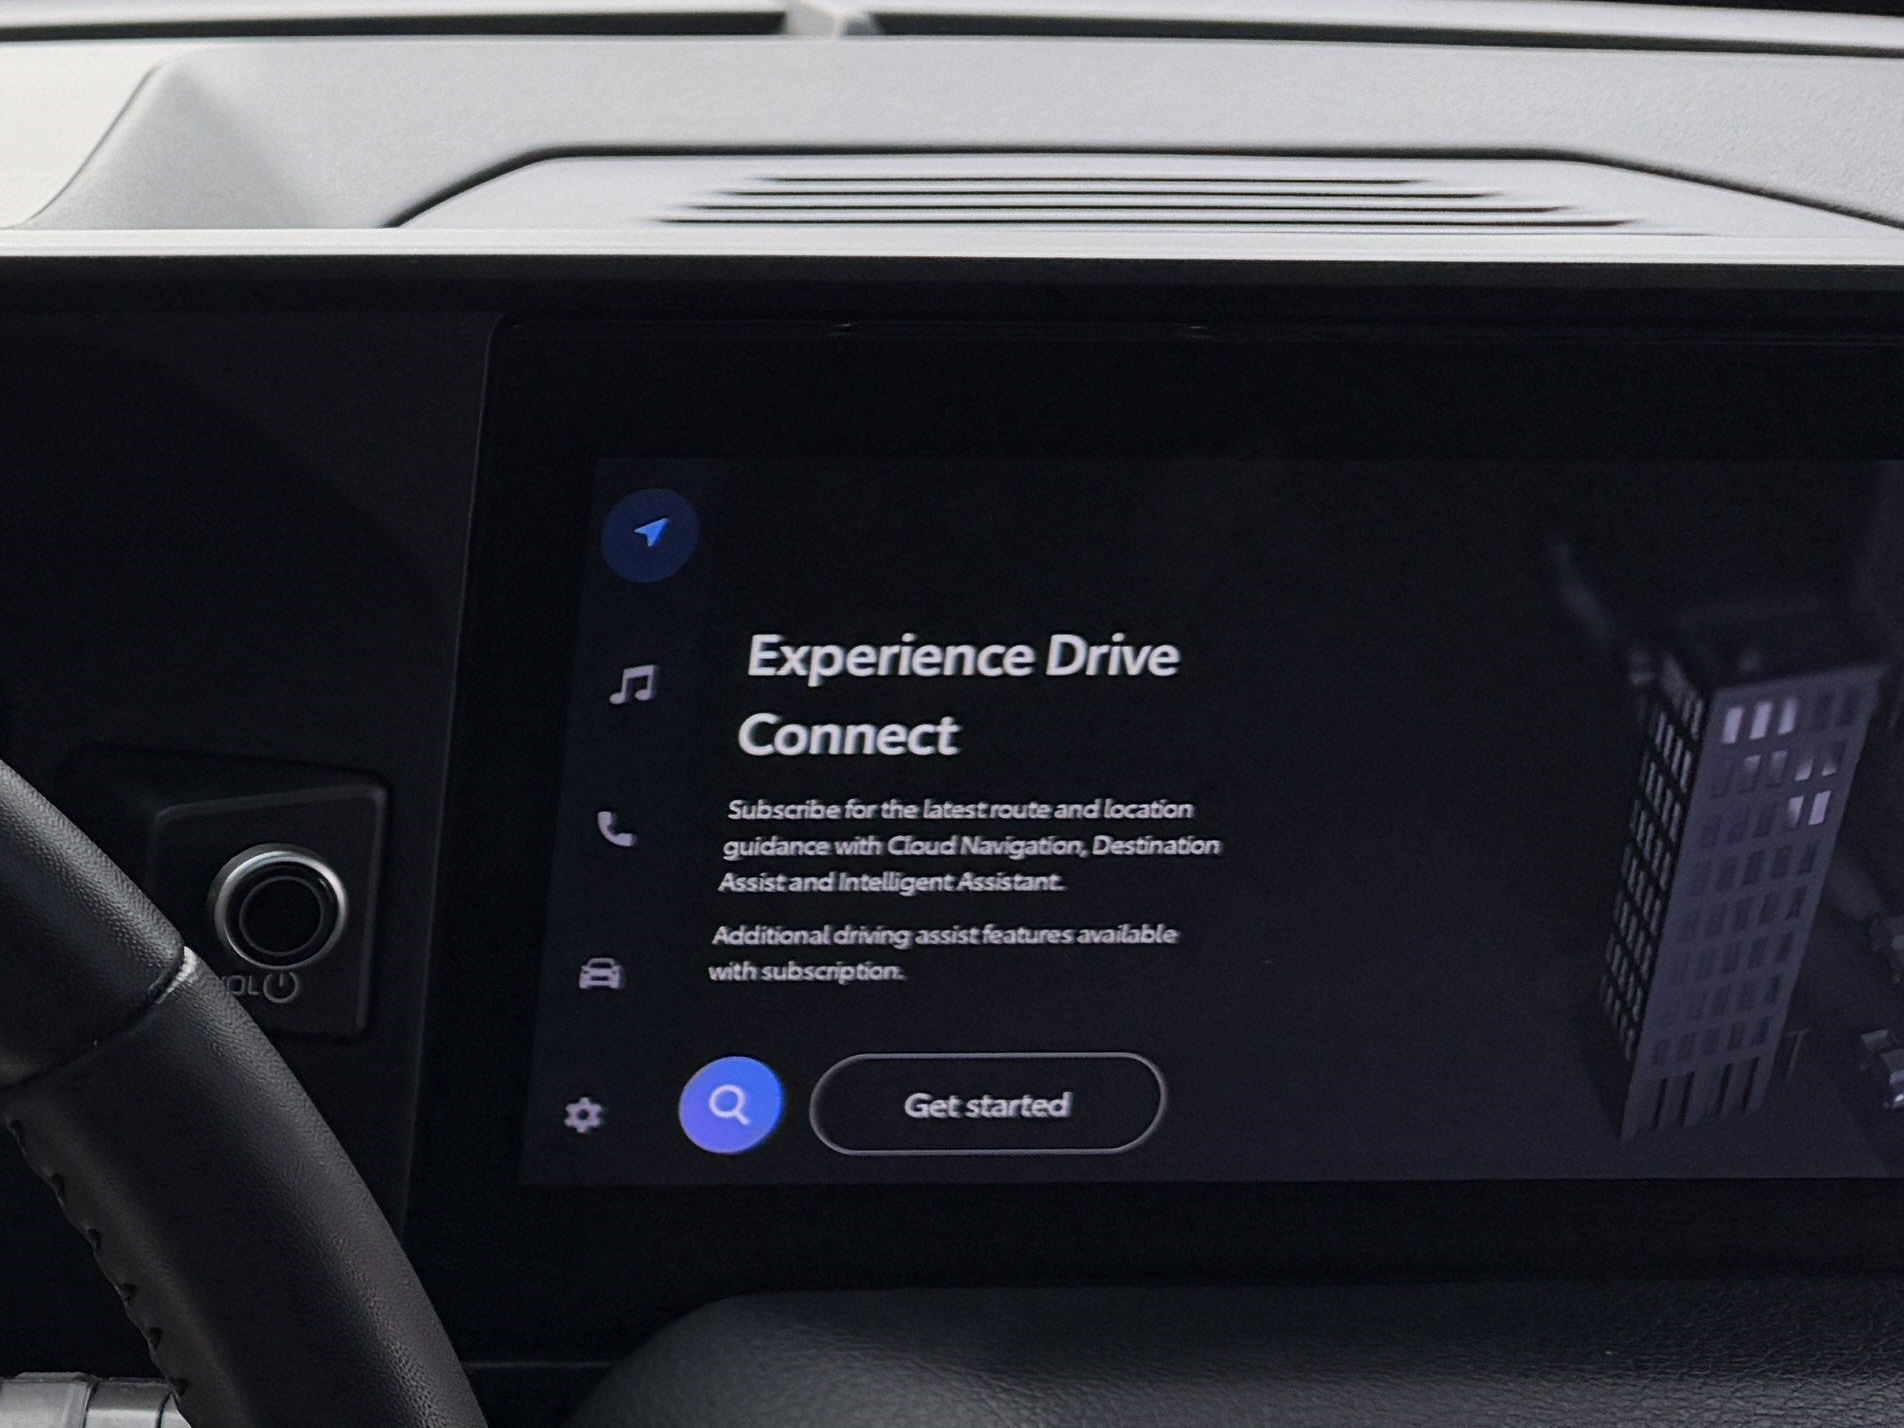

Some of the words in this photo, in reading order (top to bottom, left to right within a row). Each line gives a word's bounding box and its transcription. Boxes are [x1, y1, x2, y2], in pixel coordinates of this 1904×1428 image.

[748, 633, 1035, 687] Experience
[1046, 633, 1180, 676] Drive
[739, 713, 960, 755] Connect
[728, 799, 841, 819] Subscribe
[845, 799, 878, 819] for
[880, 799, 919, 819] the
[923, 799, 988, 818] latest
[990, 802, 1052, 818] route
[1054, 799, 1100, 818] and
[1104, 799, 1194, 818] location
[724, 836, 831, 861] guidance
[834, 836, 883, 855] with
[888, 835, 958, 855] Cloud
[960, 836, 1087, 860] Navigation,
[1092, 835, 1220, 855] Destination
[718, 873, 788, 892] Assist
[788, 872, 835, 891] and
[839, 872, 955, 896] Intelligent
[956, 872, 1064, 891] Assistant.
[712, 925, 831, 945] Additional
[833, 925, 912, 949] driving
[915, 926, 980, 944] assist
[982, 924, 1074, 944] features
[1077, 924, 1179, 943] available
[221, 975, 259, 995] OL
[709, 961, 758, 980] with
[761, 961, 904, 984] subscription.
[905, 1093, 960, 1118] Get
[966, 1092, 1072, 1117] started
